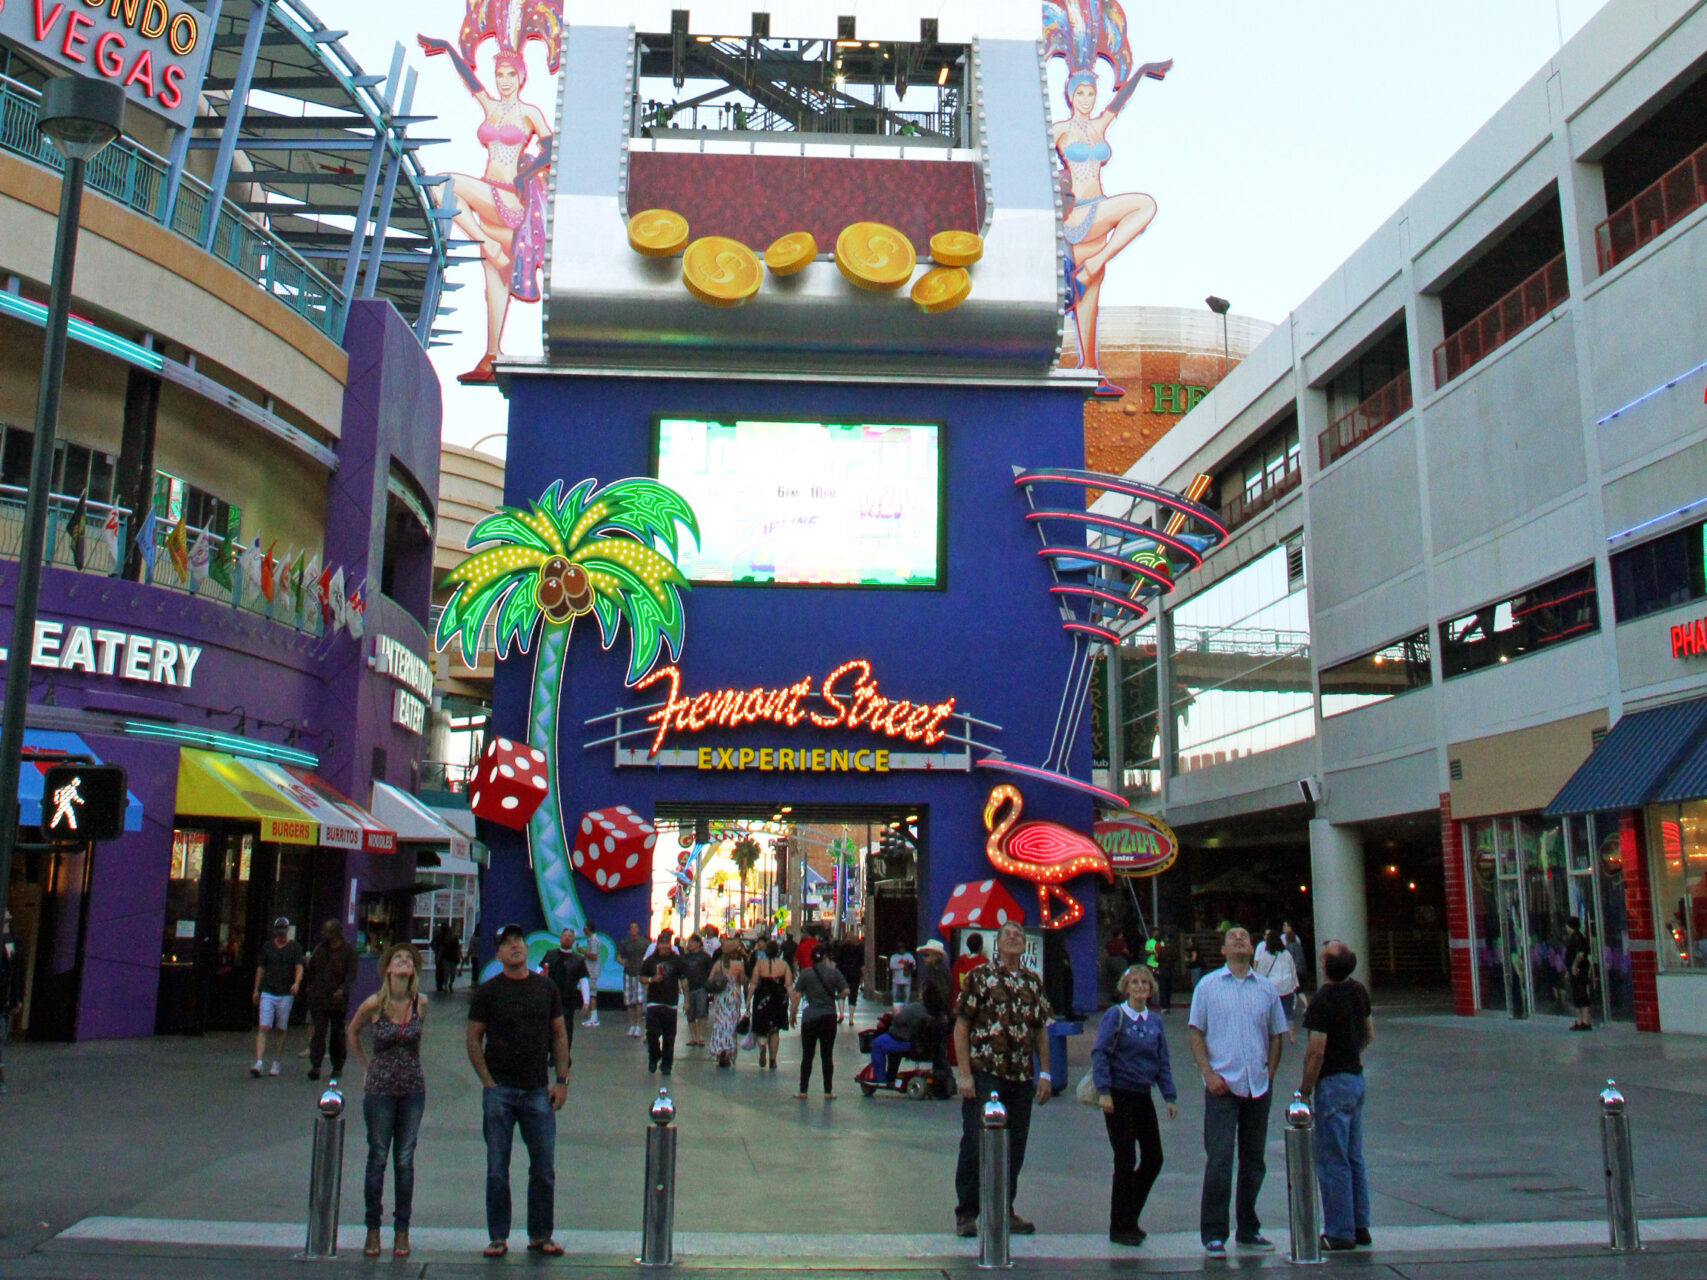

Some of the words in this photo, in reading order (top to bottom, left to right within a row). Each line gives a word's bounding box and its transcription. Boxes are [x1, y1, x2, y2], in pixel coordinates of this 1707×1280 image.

[1670, 617, 1707, 659] PHA
[30, 620, 202, 688] EATERY
[634, 665, 812, 757] Fremont
[810, 659, 956, 746] Street
[697, 745, 890, 773] EXPERIENCE
[271, 821, 310, 840] BURGERS
[325, 826, 359, 845] BURRITOS
[367, 832, 393, 850] NOODLES
